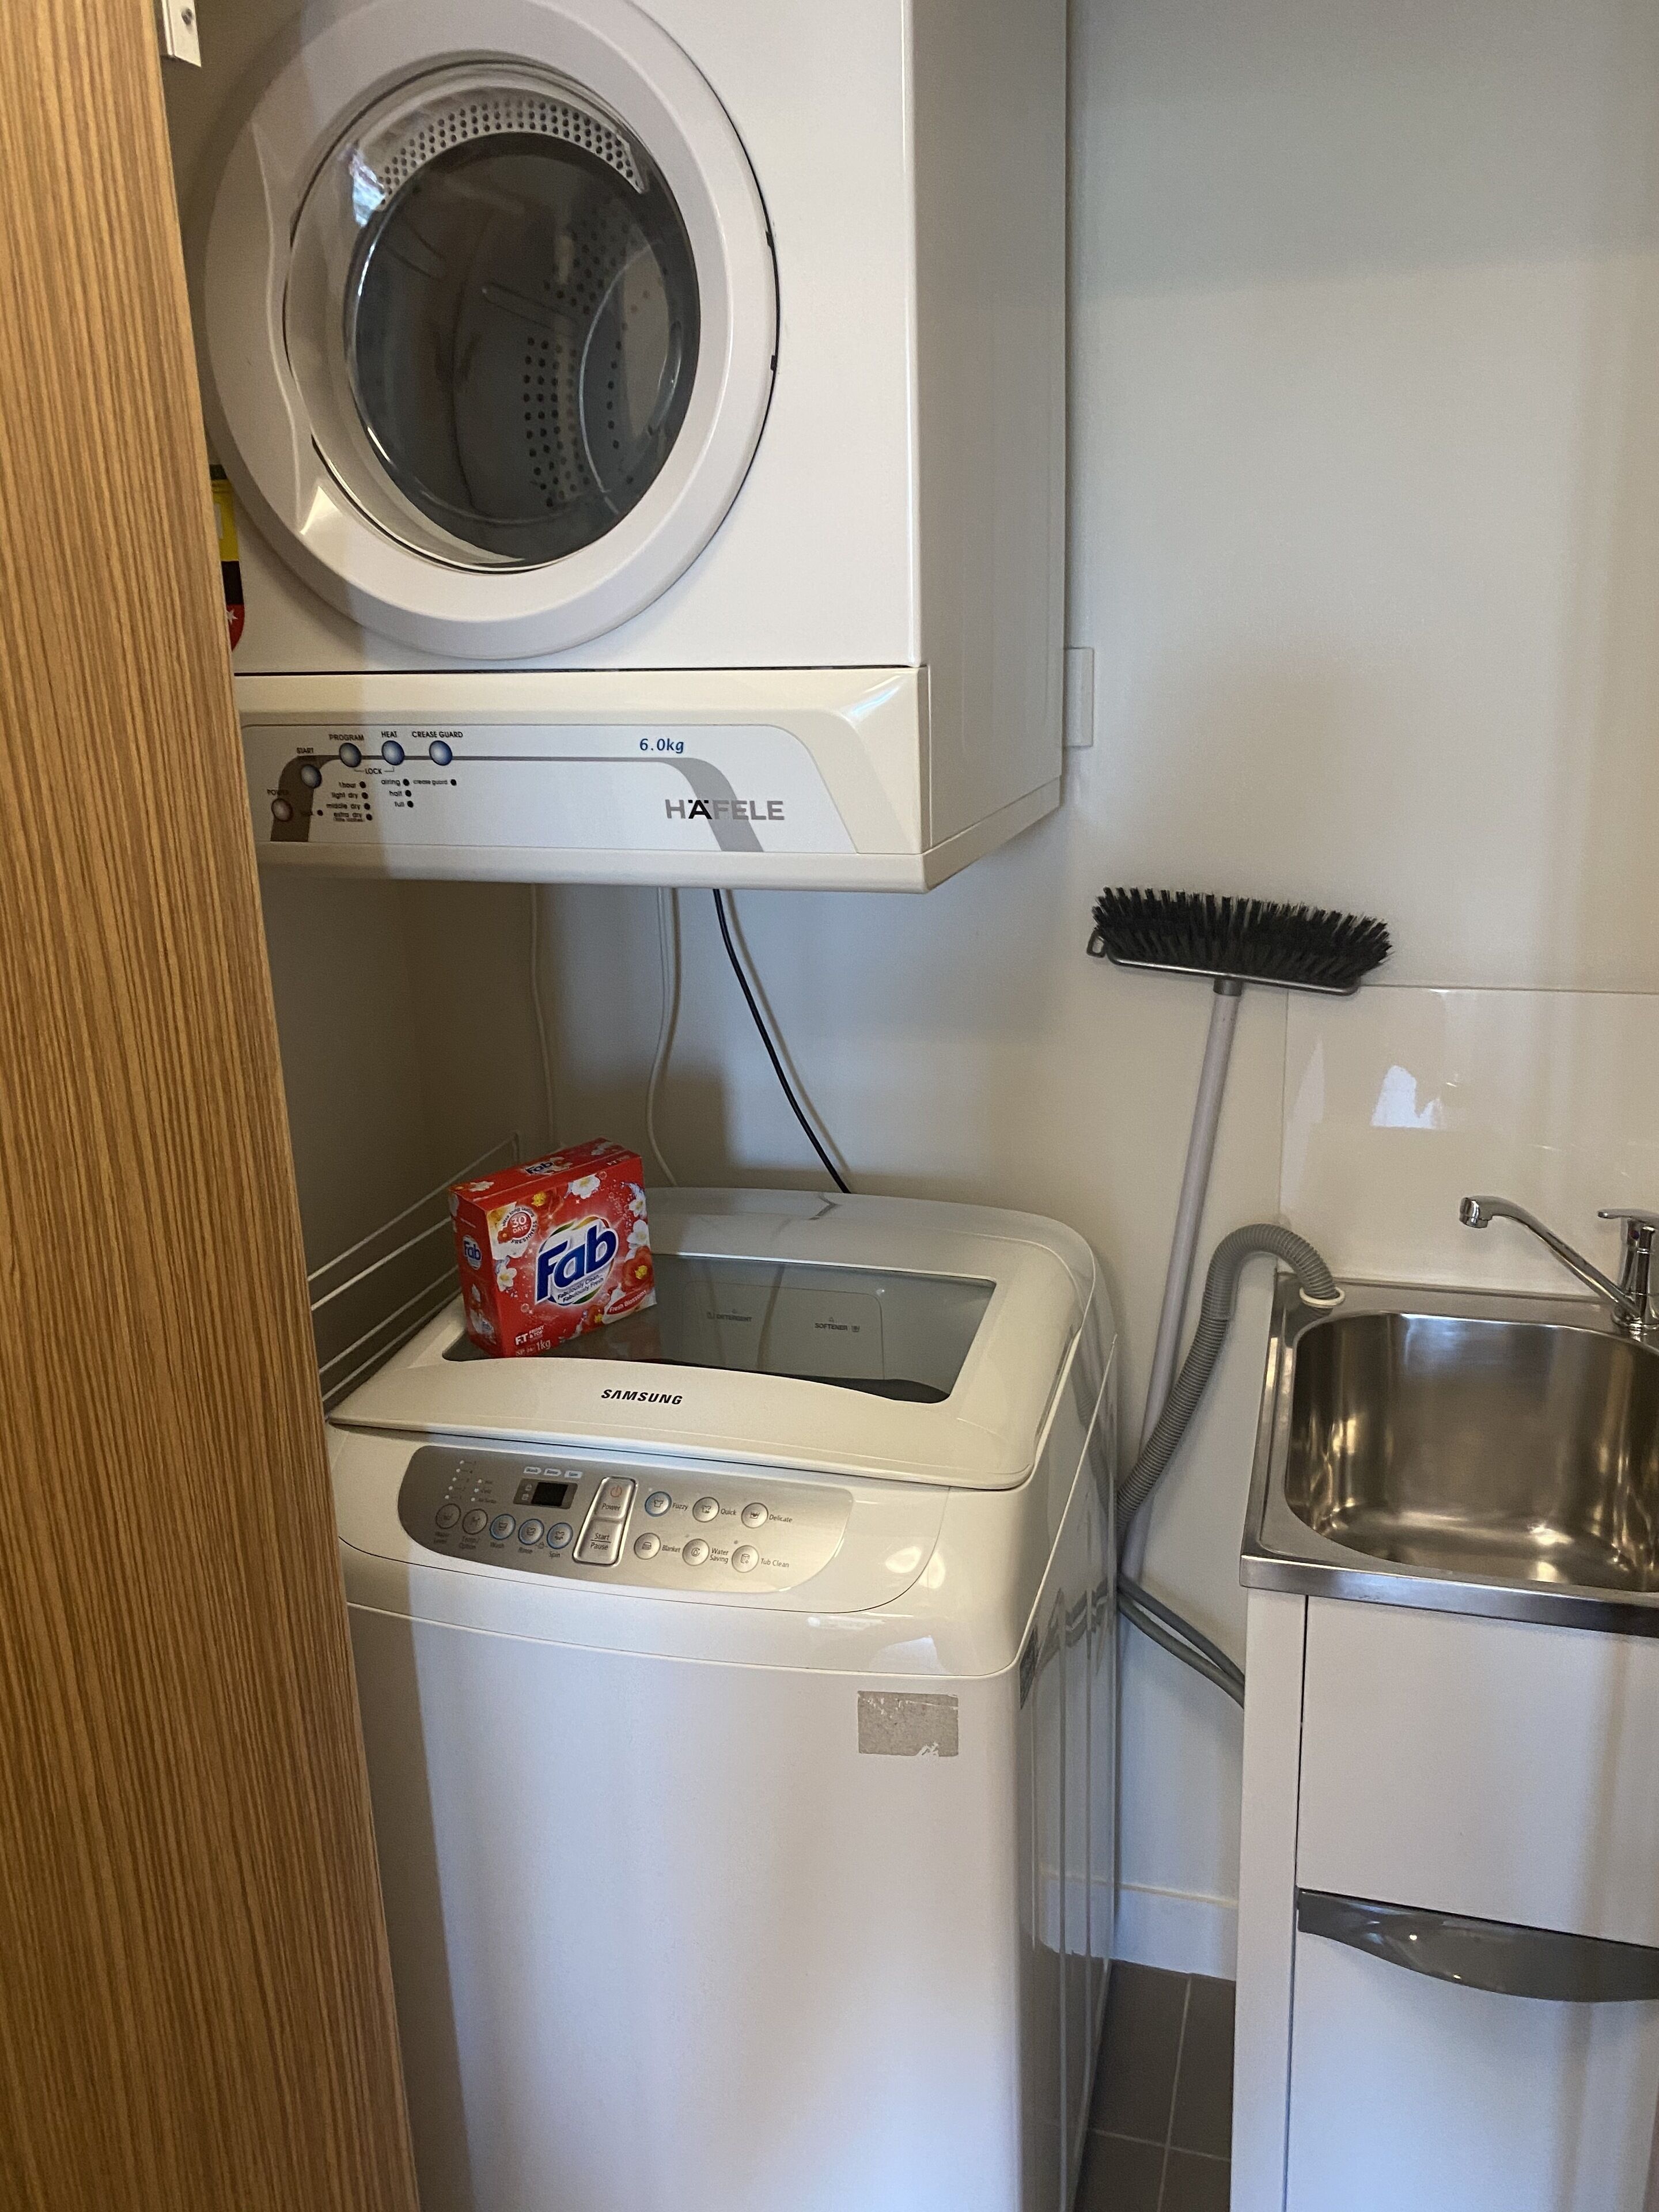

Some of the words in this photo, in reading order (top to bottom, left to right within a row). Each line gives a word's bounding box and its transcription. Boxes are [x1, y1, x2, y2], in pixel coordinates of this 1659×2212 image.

[639, 738, 684, 753] 6.0kg
[665, 799, 785, 820] HÄFELE
[525, 1161, 554, 1175] Fab
[512, 1215, 527, 1228] 30
[513, 1224, 528, 1233] DAYS
[463, 1240, 482, 1262] Fab
[536, 1225, 618, 1302] Fab
[609, 1304, 624, 1313] Fresh
[815, 1323, 848, 1331] SOFTENER
[536, 1339, 551, 1351] 1kg
[601, 1389, 683, 1406] SAMSUNG
[673, 1503, 688, 1511] Fuzzy
[769, 1514, 793, 1522] Delicate
[590, 1542, 609, 1550] Pause
[662, 1544, 681, 1552] Blanket
[549, 1551, 560, 1559] Spin
[710, 1555, 729, 1564] Saving
[772, 1559, 789, 1567] Clean
